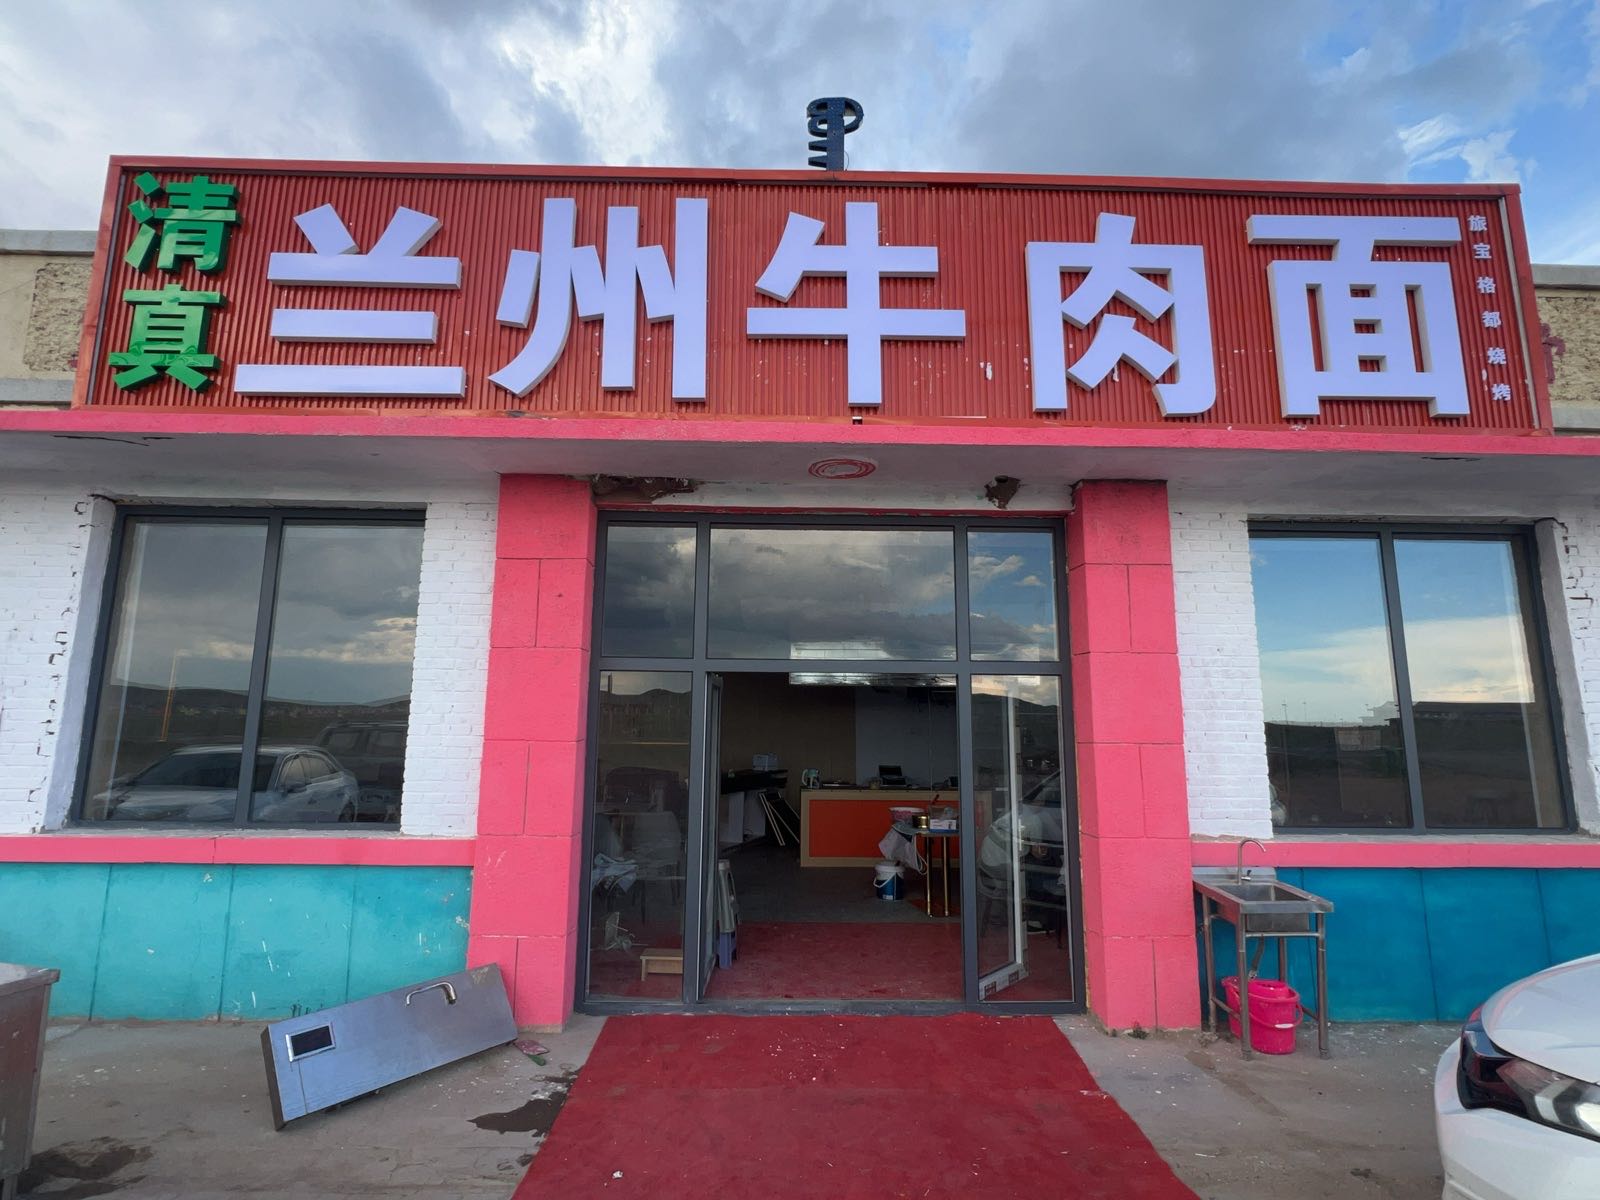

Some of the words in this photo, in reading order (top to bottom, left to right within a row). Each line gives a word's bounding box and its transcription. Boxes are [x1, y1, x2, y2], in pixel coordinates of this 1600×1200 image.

[108, 172, 239, 391] 清真
[234, 197, 1471, 418] 兰州牛肉面
